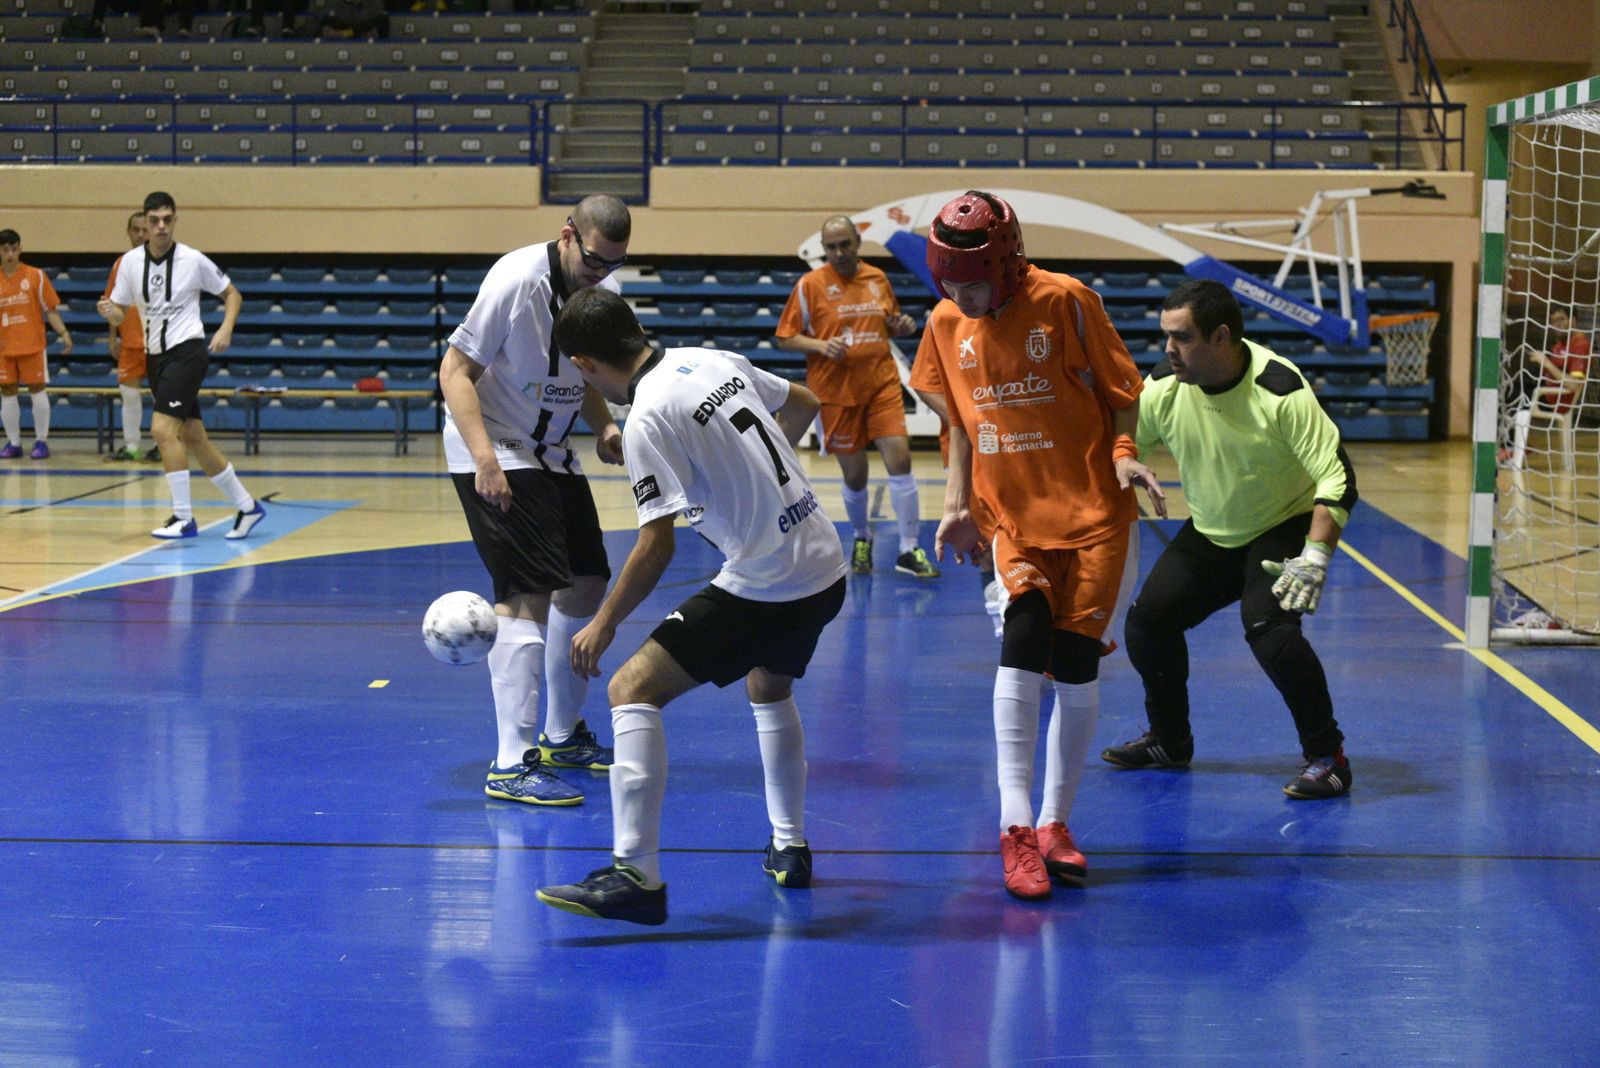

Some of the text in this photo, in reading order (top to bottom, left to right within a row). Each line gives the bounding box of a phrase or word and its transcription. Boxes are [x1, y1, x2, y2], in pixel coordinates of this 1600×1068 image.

[544, 384, 571, 396] Gran
[692, 376, 746, 427] EDUARDO
[729, 407, 790, 487] 7
